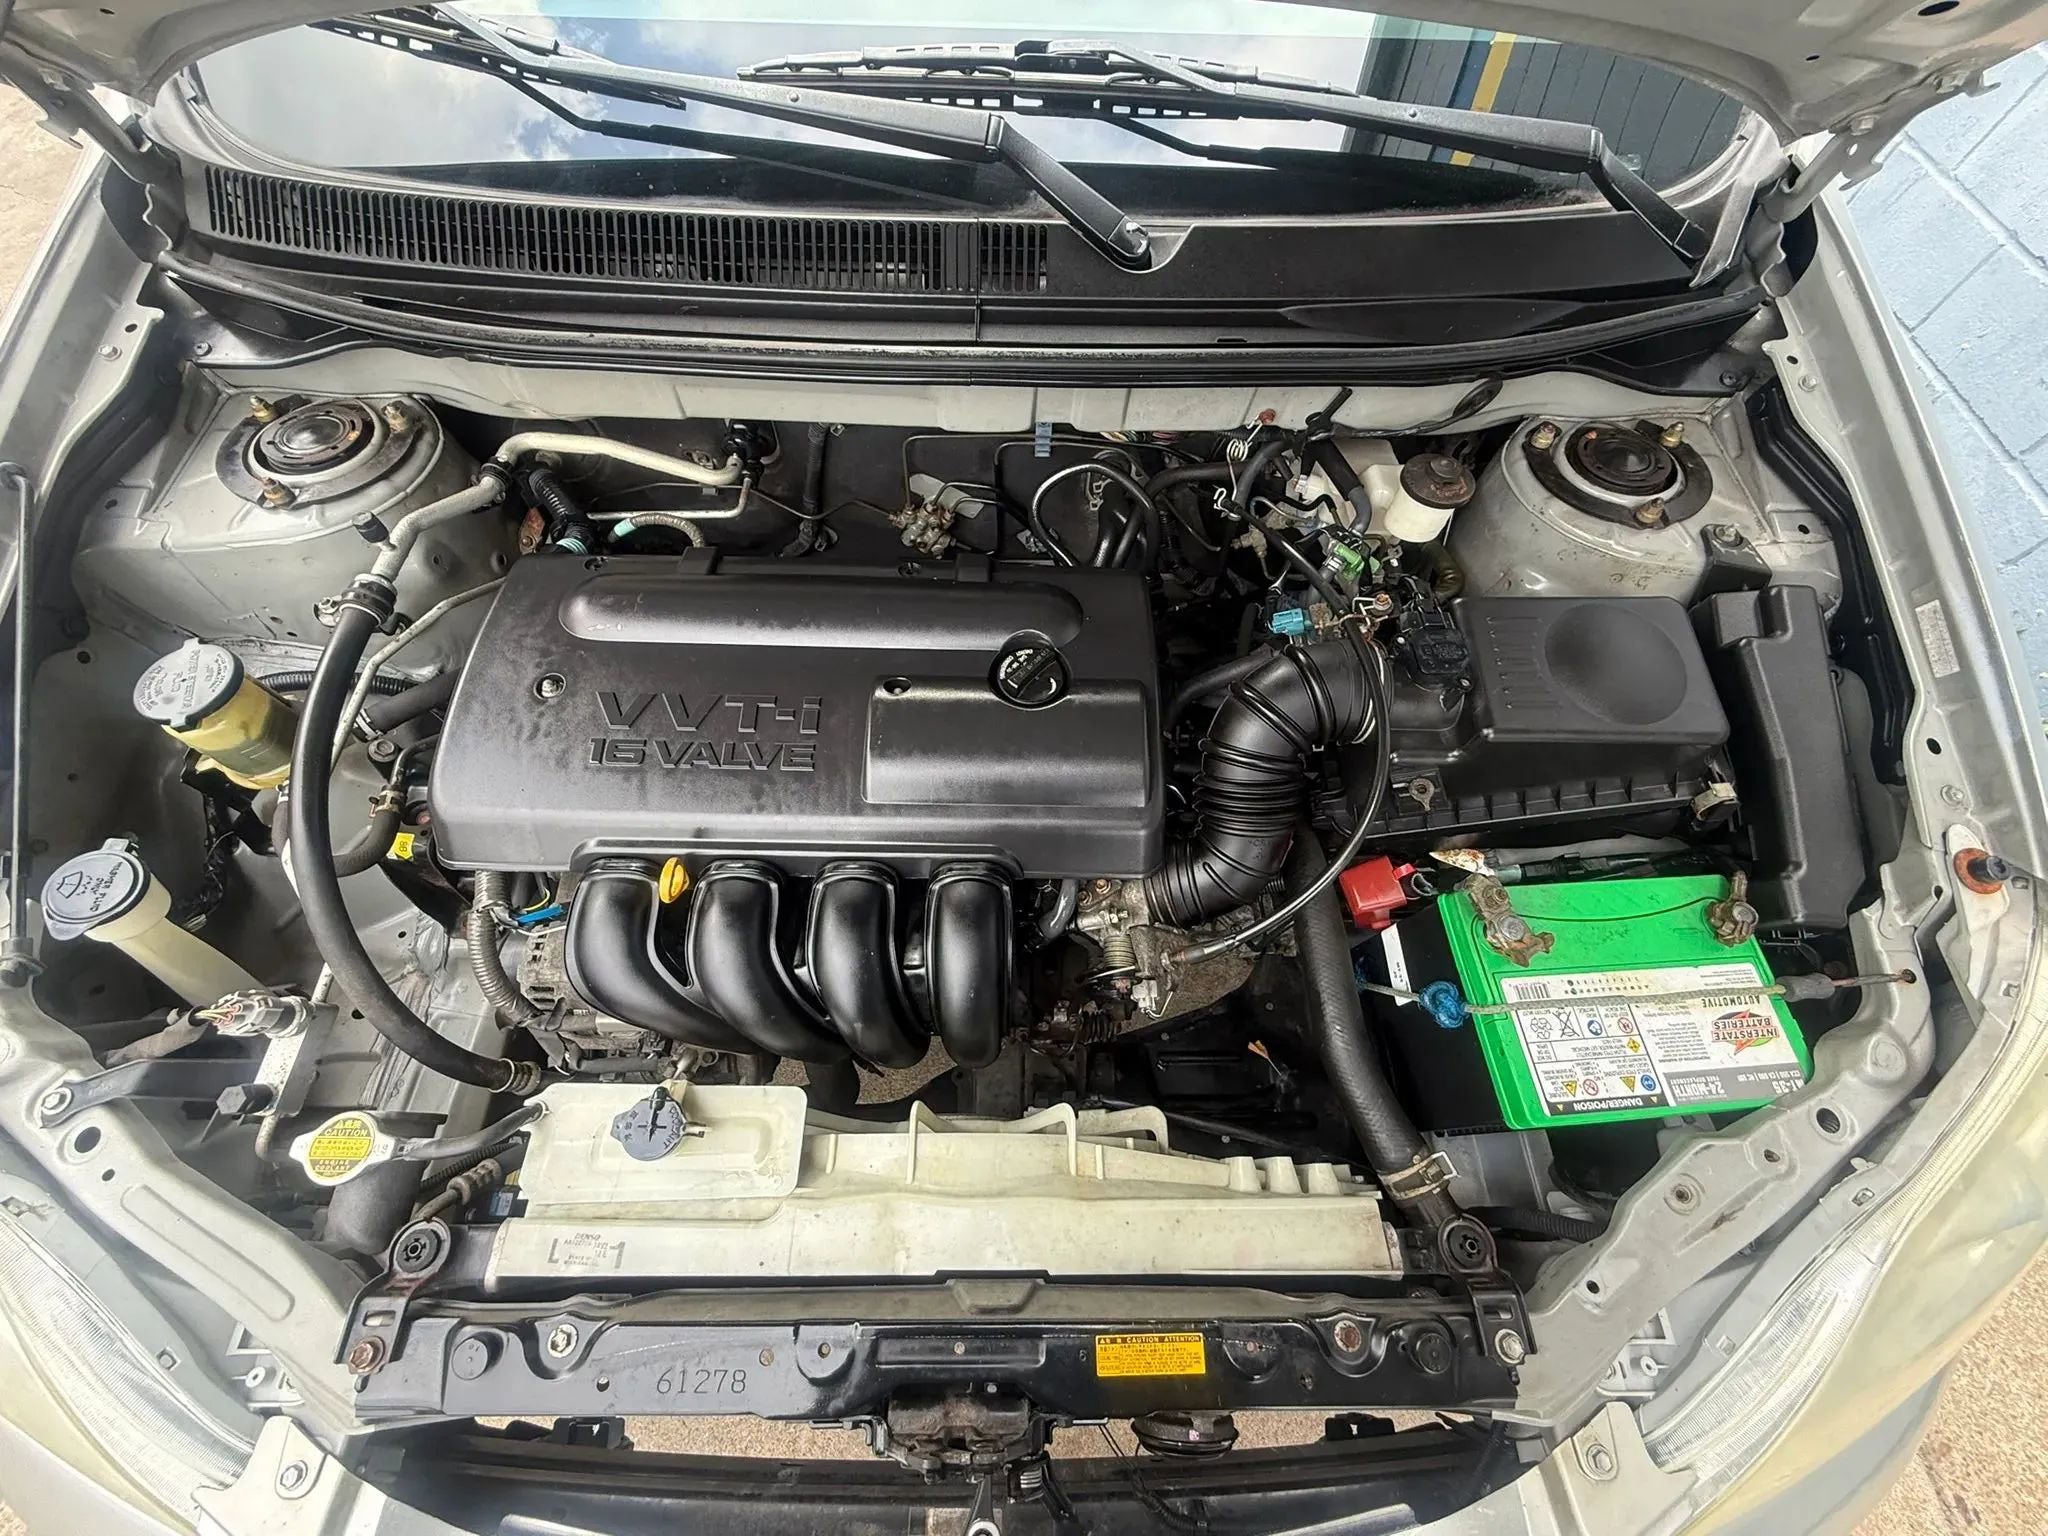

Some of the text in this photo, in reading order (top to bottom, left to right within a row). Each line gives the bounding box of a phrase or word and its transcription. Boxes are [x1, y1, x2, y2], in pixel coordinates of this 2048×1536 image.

[596, 691, 822, 734] VVT-i
[589, 737, 816, 771] 16 VALVE
[1701, 994, 1761, 1008] AUTOMOTIVE
[1713, 1017, 1771, 1030] BATTERIES
[1714, 1027, 1779, 1041] INTERSTATE
[1672, 1080, 1724, 1098] 24-MONTH
[1573, 1097, 1643, 1111] DANGER/POISON
[324, 1127, 368, 1137] CAUTION
[1126, 1335, 1159, 1343] CAUTION
[1163, 1335, 1200, 1343] ATTENTION
[656, 1366, 747, 1395] 61278
